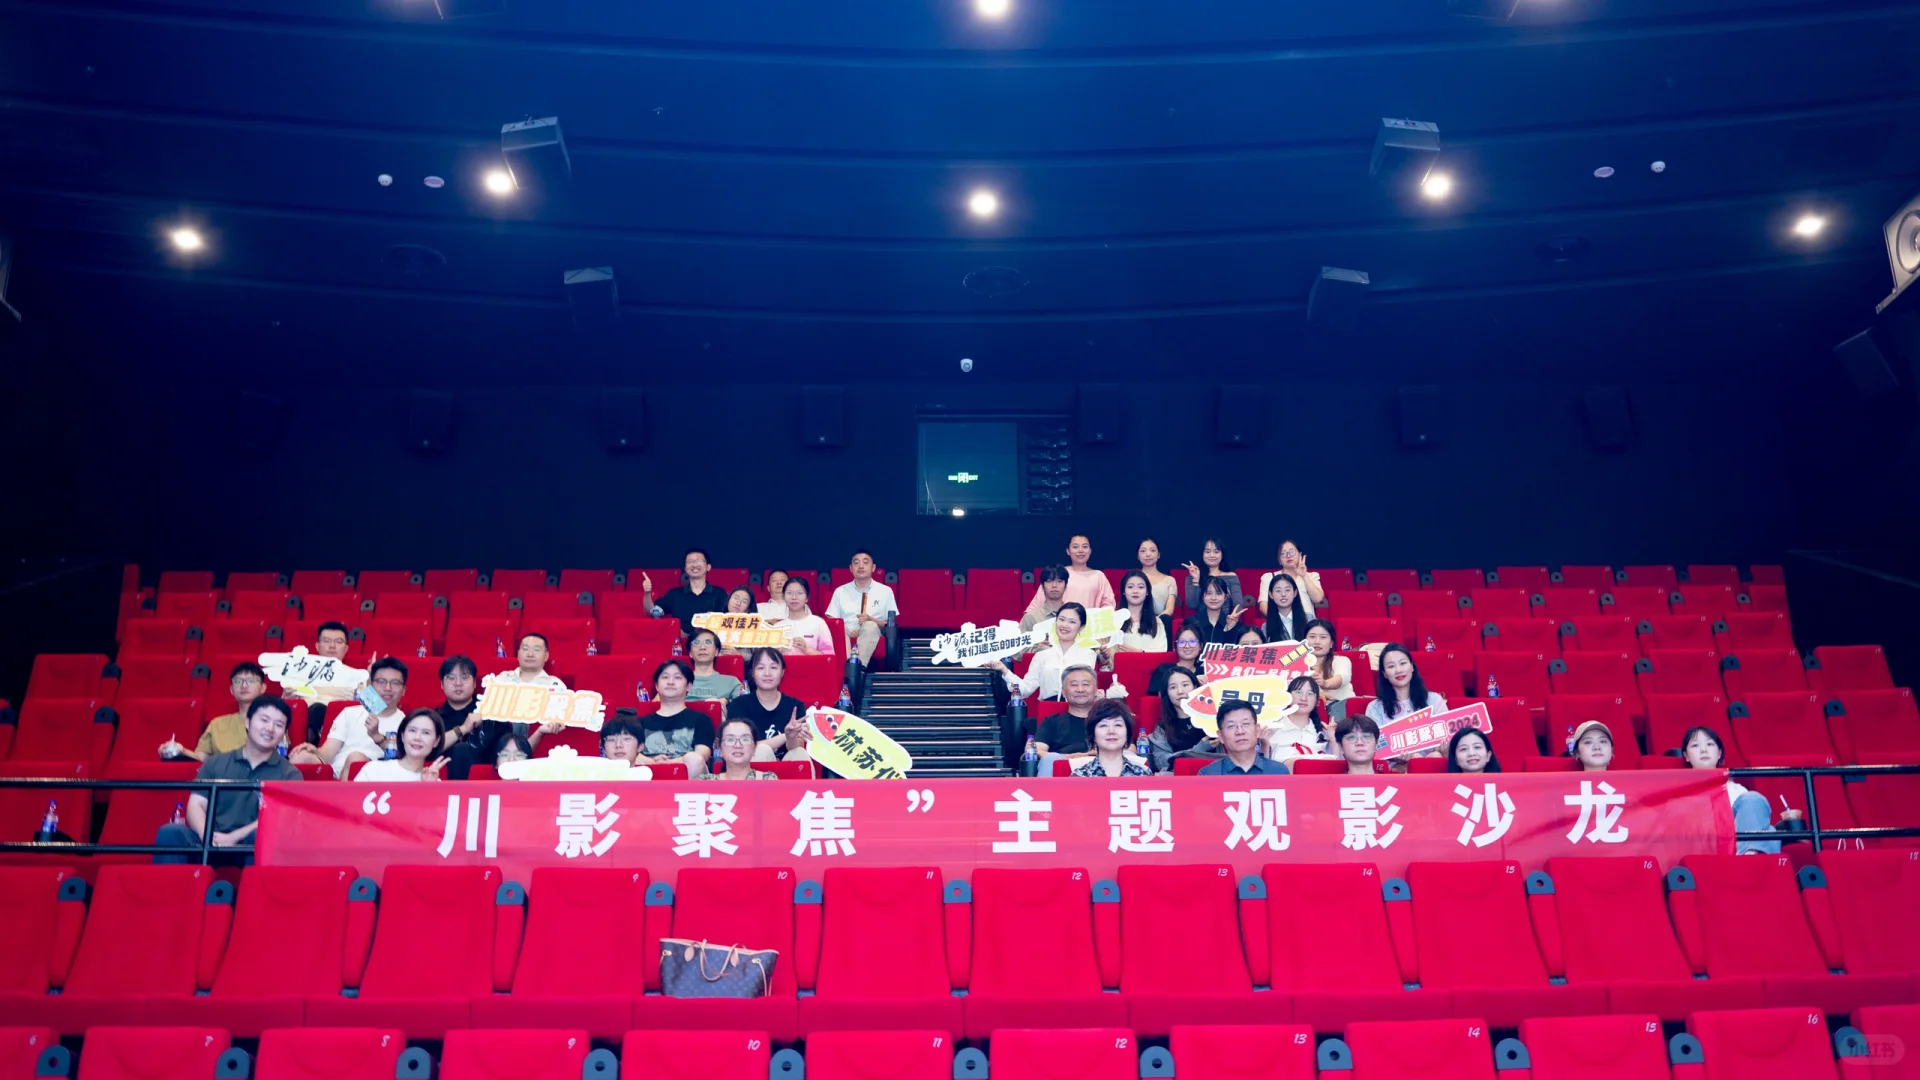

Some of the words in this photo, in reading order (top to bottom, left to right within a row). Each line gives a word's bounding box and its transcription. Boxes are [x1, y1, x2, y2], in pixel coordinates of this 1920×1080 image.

[956, 635, 1033, 659] 我们遗忘的时光
[1201, 643, 1279, 666] 川影聚焦
[481, 685, 598, 722] 川影聚焦
[1390, 721, 1447, 752] 川影聚焦
[1448, 712, 1481, 734] 2024
[1643, 860, 1653, 870] 16
[1778, 857, 1788, 867] 17
[777, 870, 788, 880] 10
[926, 870, 935, 880] 11
[1217, 867, 1229, 877] 13
[1362, 867, 1373, 877] 14
[1505, 865, 1516, 874] 15
[632, 873, 640, 883] 9
[1071, 871, 1083, 881] 12
[1807, 1013, 1819, 1025] 16
[1467, 1026, 1481, 1038] 14
[1645, 1021, 1657, 1033] 15
[567, 1037, 577, 1049] 9
[747, 1039, 761, 1051] 10
[932, 1037, 943, 1048] 11
[1114, 1037, 1128, 1049] 12
[1293, 1033, 1308, 1045] 13
